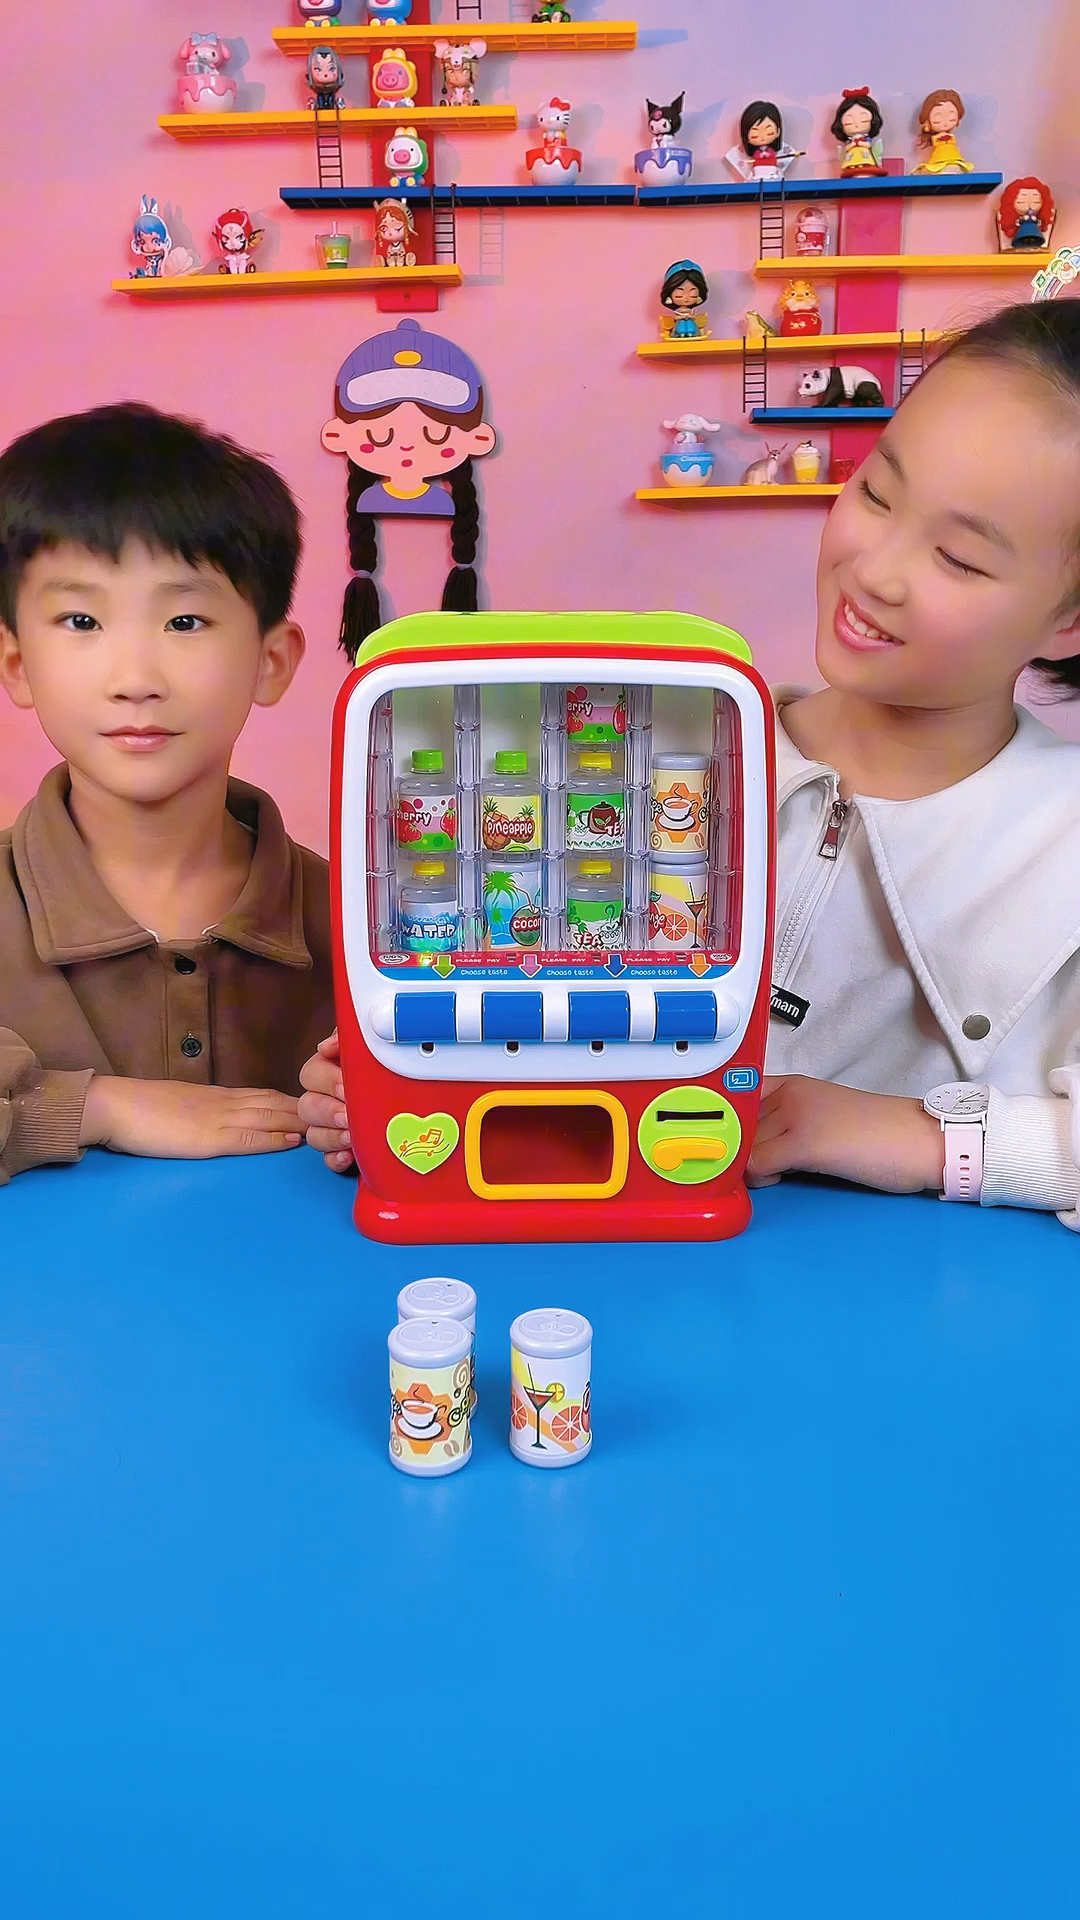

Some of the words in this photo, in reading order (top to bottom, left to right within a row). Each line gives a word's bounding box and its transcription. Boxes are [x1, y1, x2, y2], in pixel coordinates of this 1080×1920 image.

[487, 820, 534, 836] Pineapple
[573, 931, 604, 947] TEA
[657, 968, 678, 976] taste
